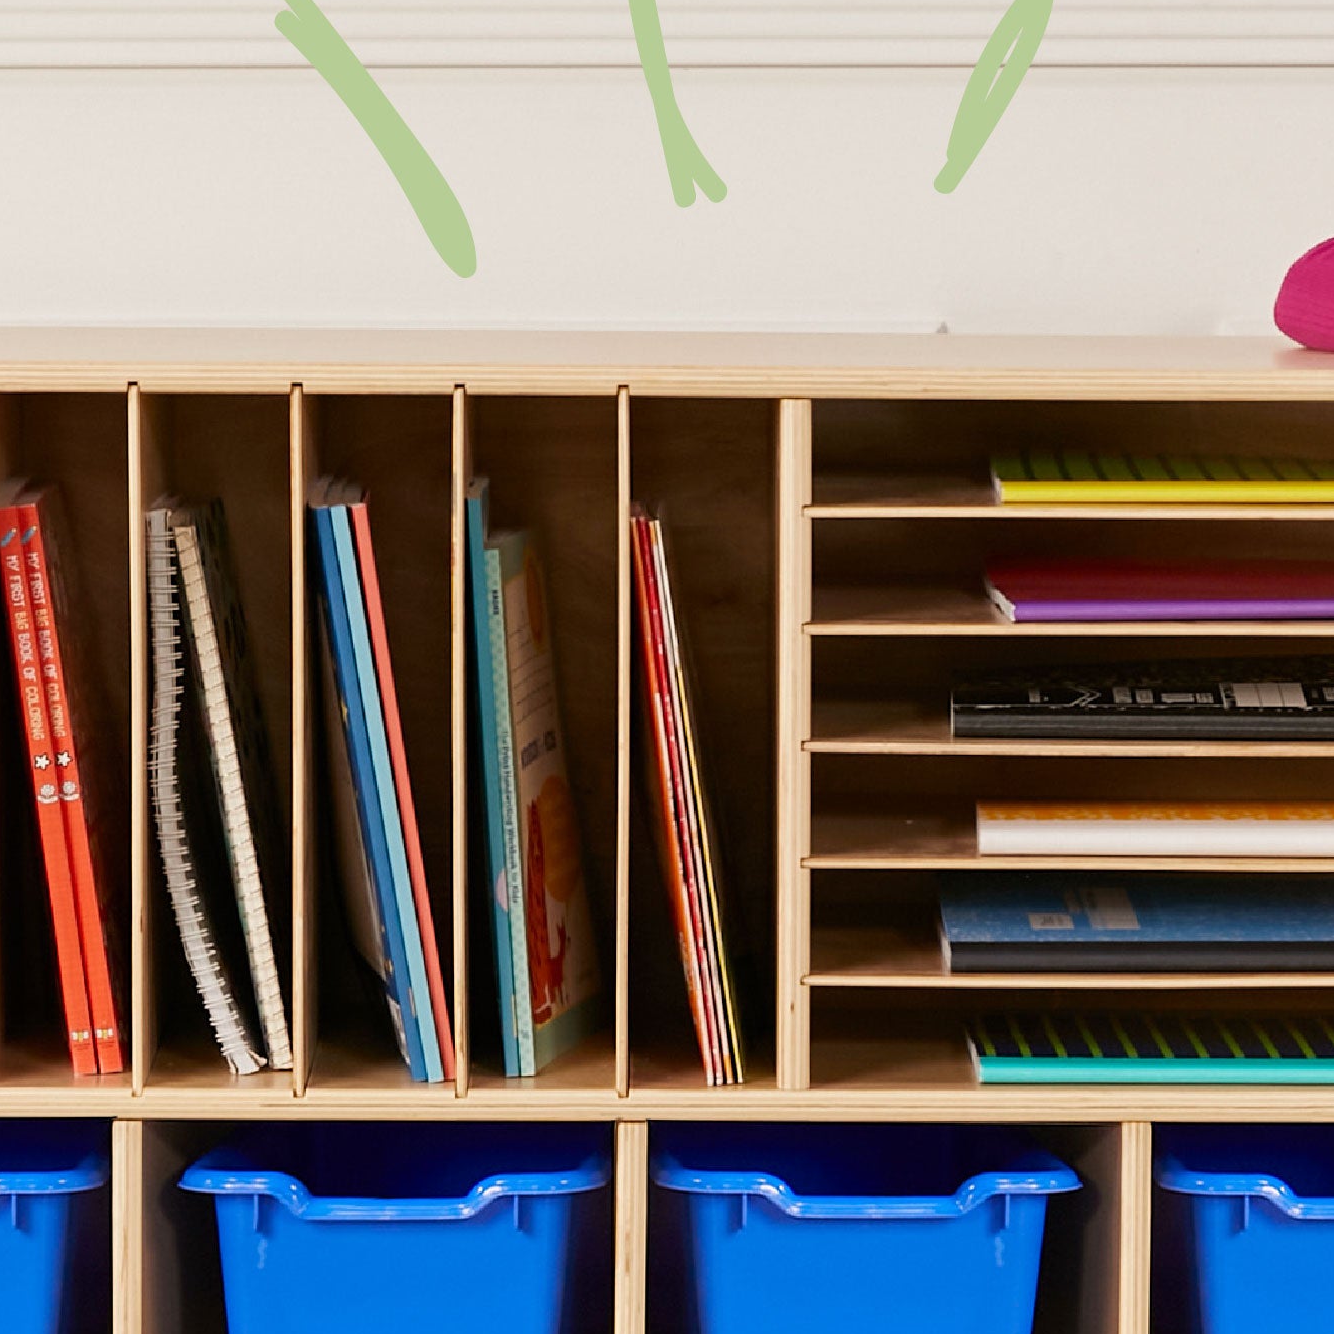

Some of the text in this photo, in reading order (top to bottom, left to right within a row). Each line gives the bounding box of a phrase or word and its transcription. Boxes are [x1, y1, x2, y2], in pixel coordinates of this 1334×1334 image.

[9, 575, 25, 607] FIRST
[29, 572, 46, 605] FIRST
[14, 611, 29, 630] BIG
[18, 633, 34, 664] BOOK
[38, 630, 54, 660] BOOK
[23, 667, 37, 682] OF
[44, 664, 58, 679] OF
[25, 686, 45, 741] COLORING
[47, 683, 66, 738] COLORING
